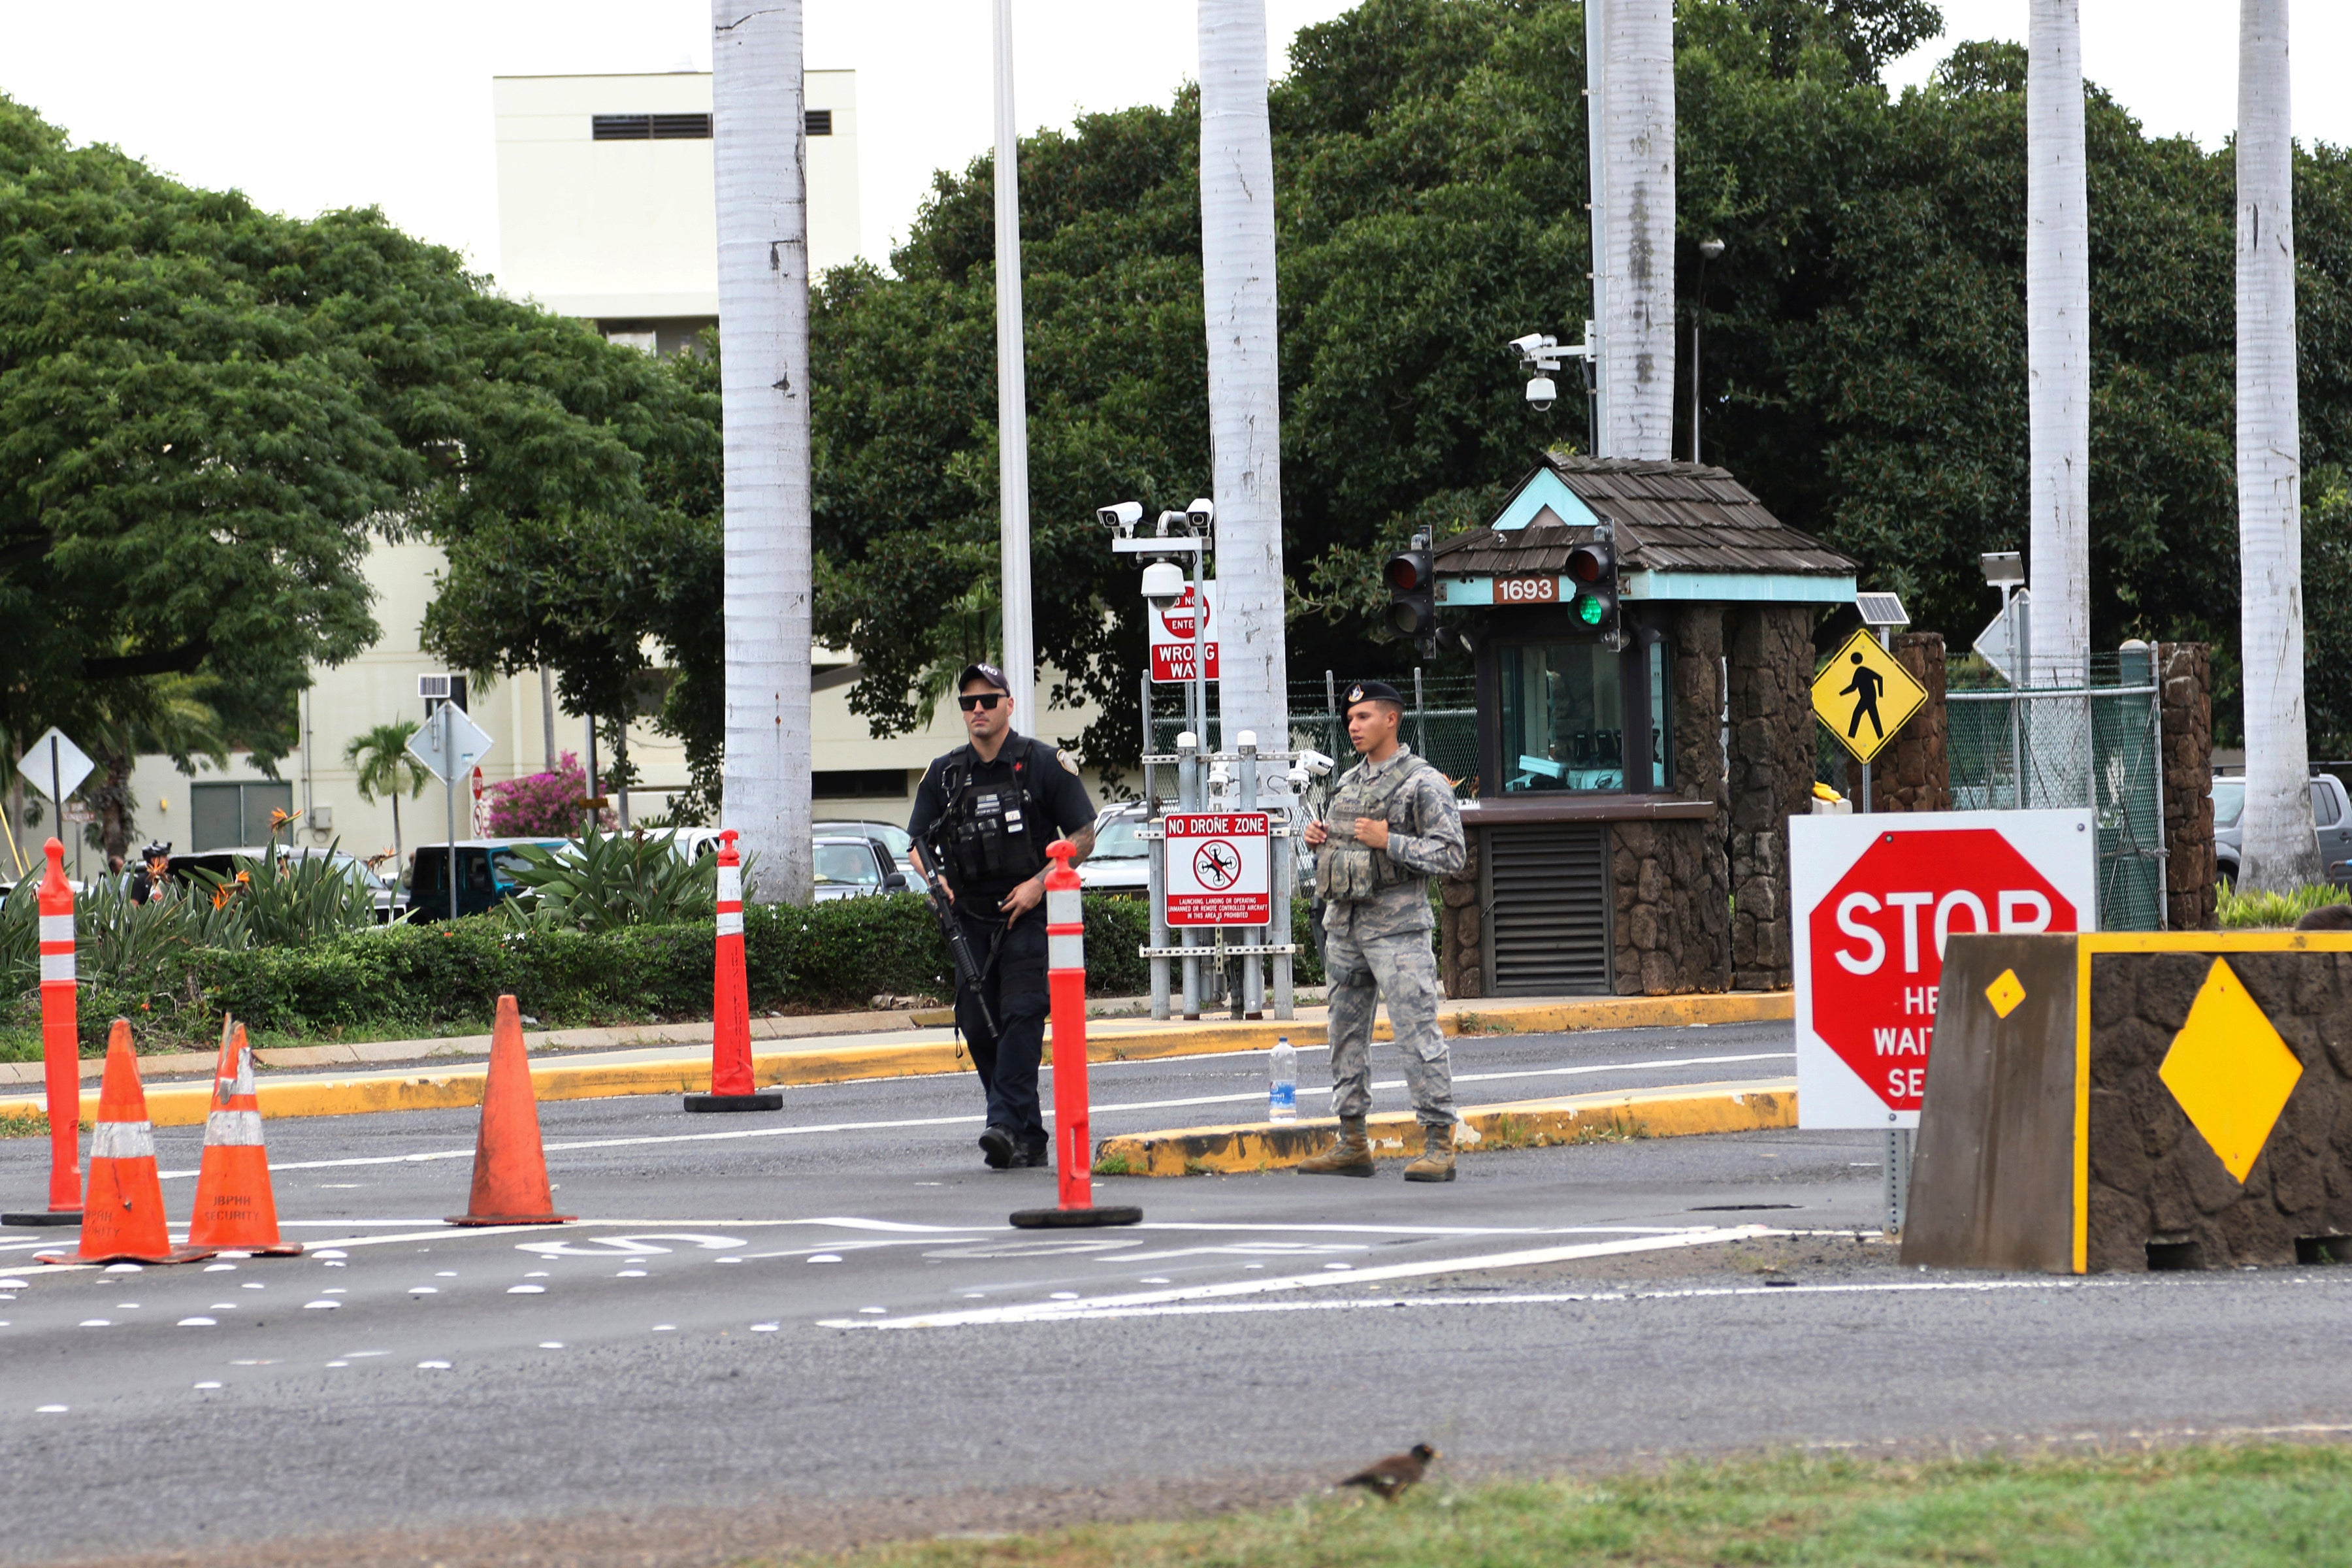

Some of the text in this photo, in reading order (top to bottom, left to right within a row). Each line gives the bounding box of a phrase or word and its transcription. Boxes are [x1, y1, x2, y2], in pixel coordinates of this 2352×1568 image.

[1499, 579, 1552, 600] 1693
[1172, 619, 1194, 630] ENTE
[1159, 645, 1215, 662] WROG
[472, 777, 482, 791] STOP
[1168, 817, 1265, 834] NO DRONE ZONE
[1835, 889, 2053, 975] STOP
[214, 1196, 251, 1207] JBPHH
[204, 1211, 259, 1222] SECURITY
